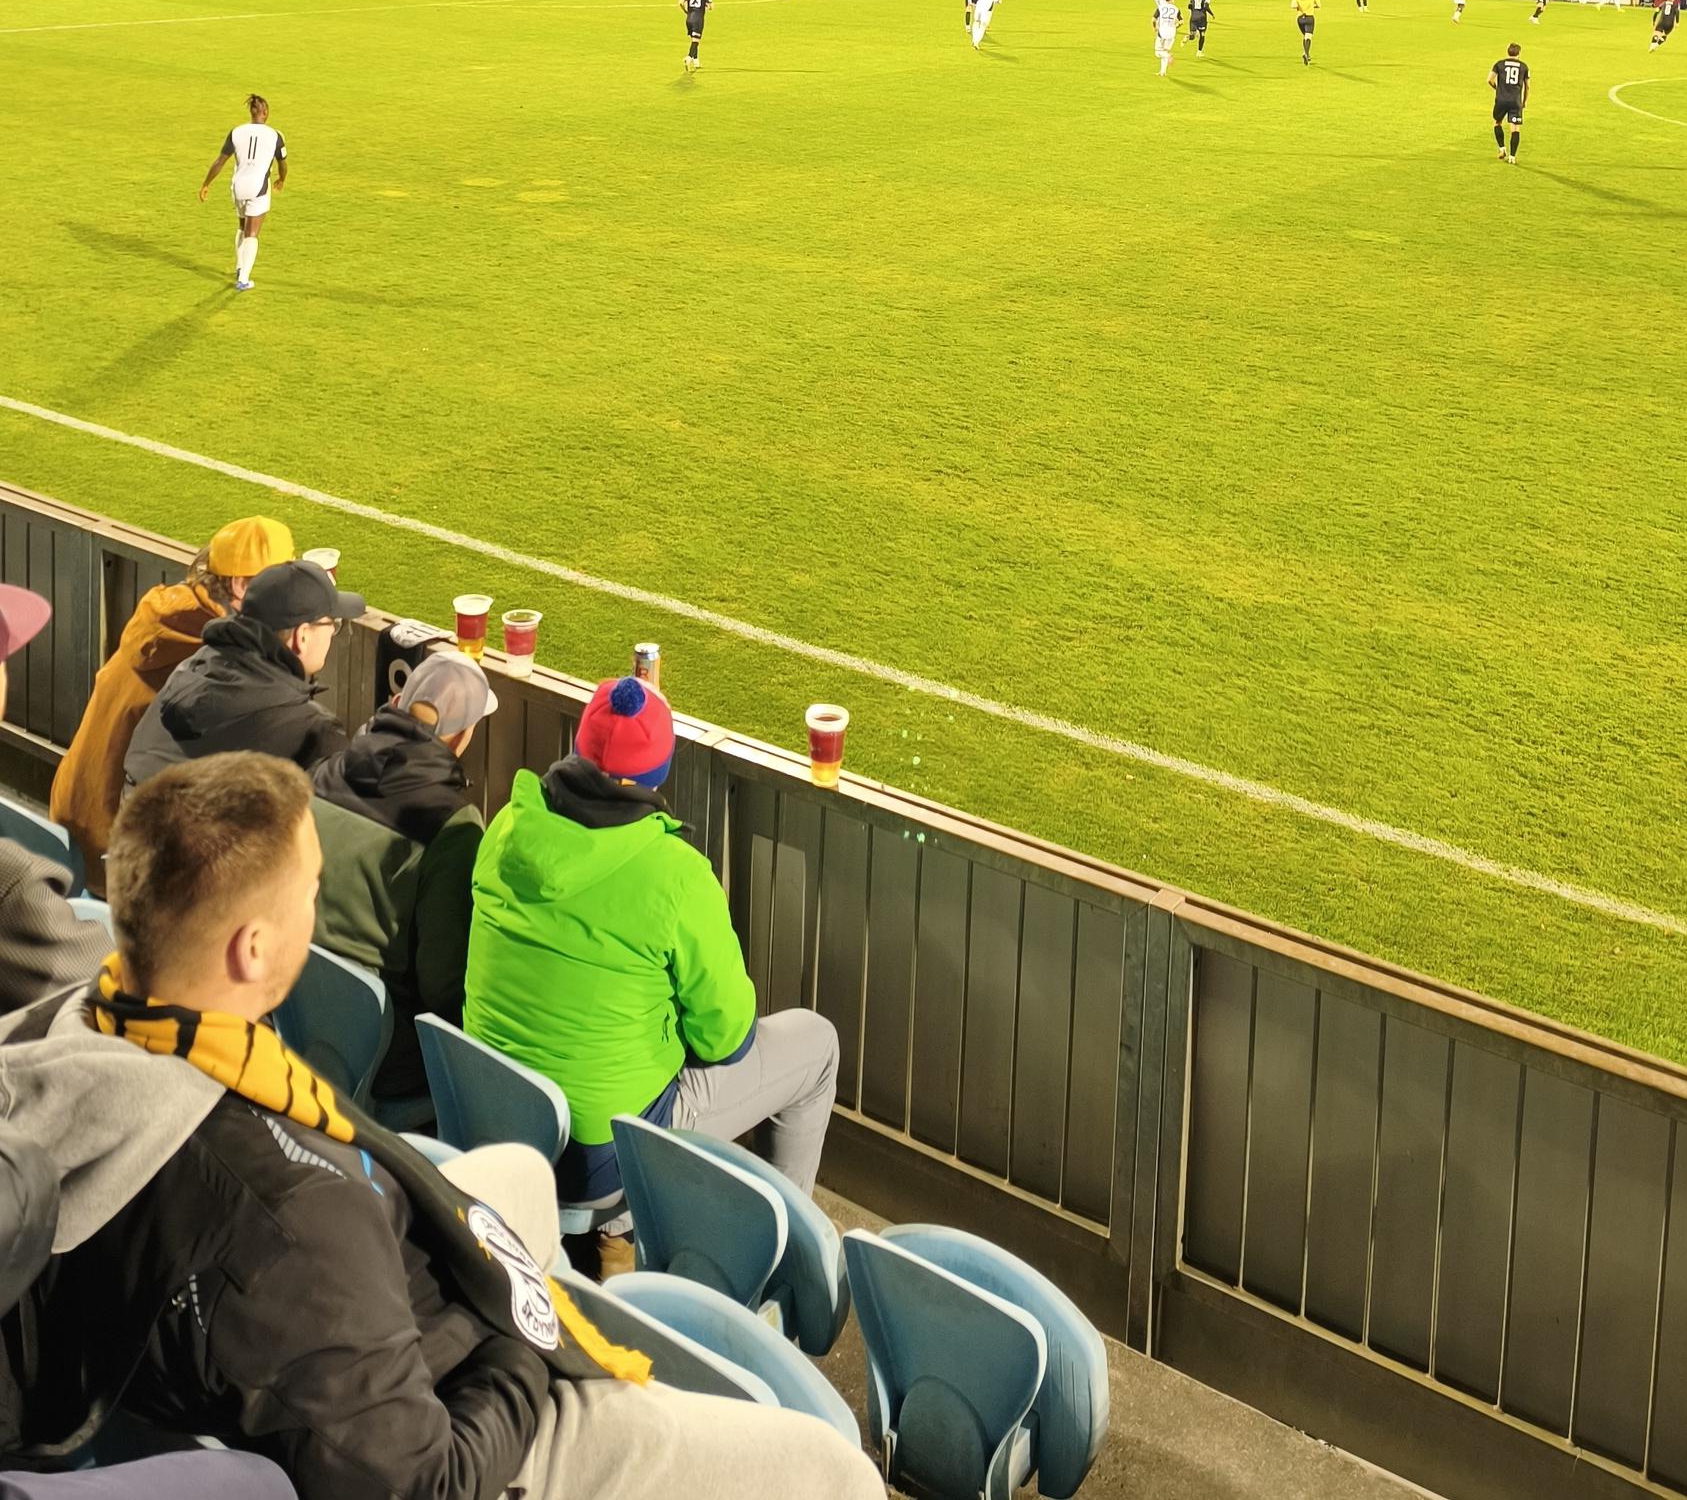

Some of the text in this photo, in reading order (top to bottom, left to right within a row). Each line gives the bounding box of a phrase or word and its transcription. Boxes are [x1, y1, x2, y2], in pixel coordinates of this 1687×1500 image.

[1161, 7, 1176, 20] 22
[1504, 66, 1520, 85] 19
[247, 135, 259, 160] 11
